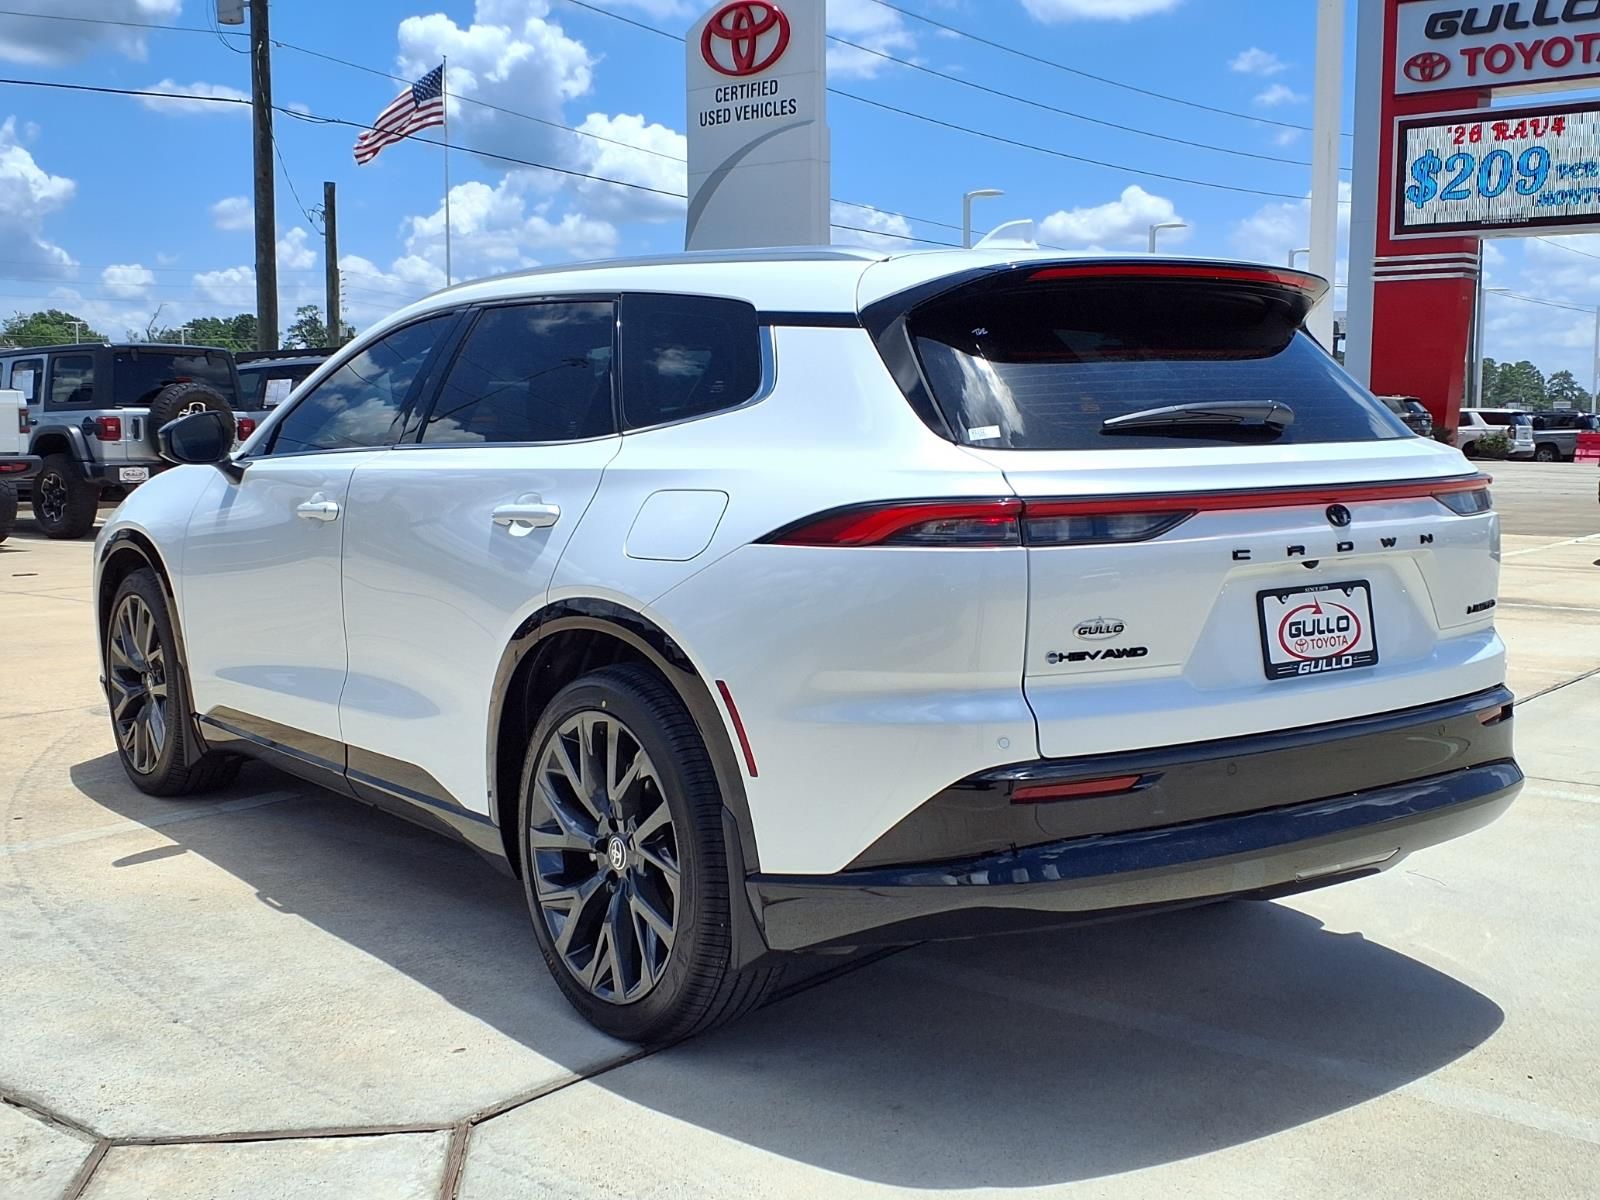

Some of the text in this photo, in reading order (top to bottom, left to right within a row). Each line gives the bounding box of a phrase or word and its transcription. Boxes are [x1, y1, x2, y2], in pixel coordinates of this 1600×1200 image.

[1460, 33, 1600, 76] TOYOT
[715, 80, 778, 103] CERTIFIED
[700, 98, 797, 127] USED VEHICLES
[1491, 117, 1566, 142] RAV4
[1406, 146, 1550, 209] $209
[1078, 624, 1125, 636] GULLO
[1288, 615, 1350, 639] GULLO
[1310, 635, 1349, 650] TOYOTA
[1058, 647, 1148, 662] HEV AWD
[1298, 655, 1353, 674] GULLO
